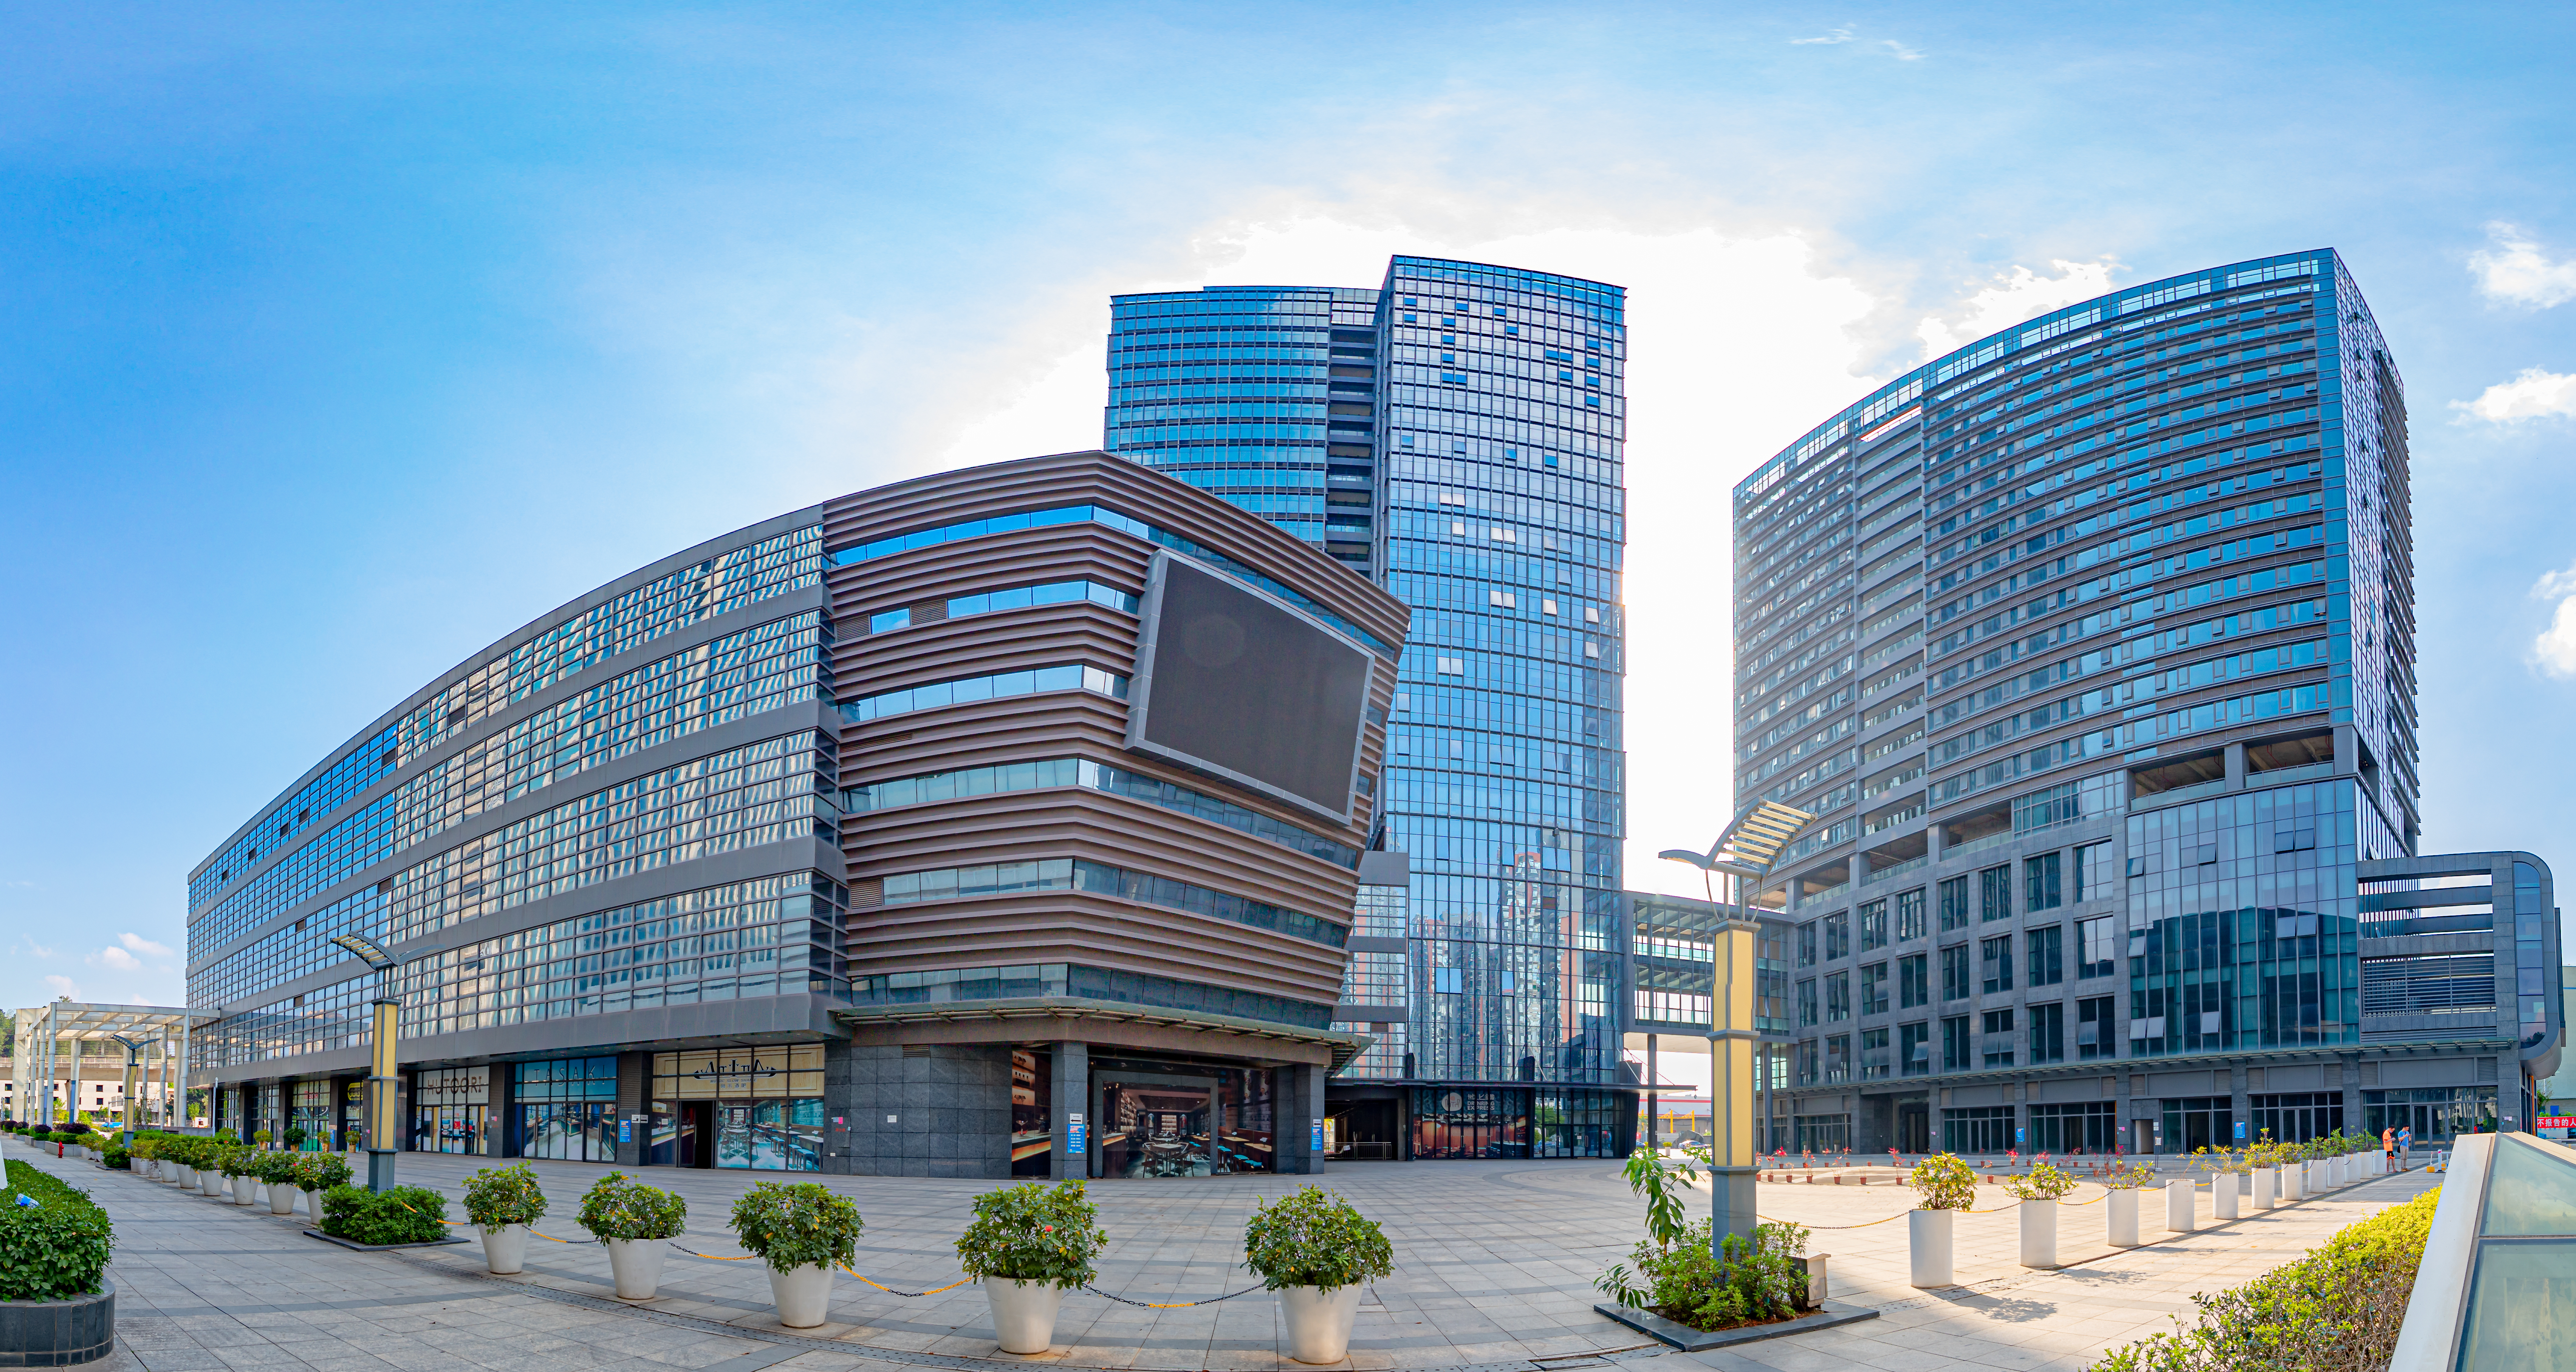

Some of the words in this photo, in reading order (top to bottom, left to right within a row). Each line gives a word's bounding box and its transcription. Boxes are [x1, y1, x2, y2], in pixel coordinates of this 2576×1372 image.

[534, 1065, 605, 1086] TASAKI
[427, 1076, 482, 1095] HUTOORI
[2537, 1118, 2576, 1127] 不报告的人
